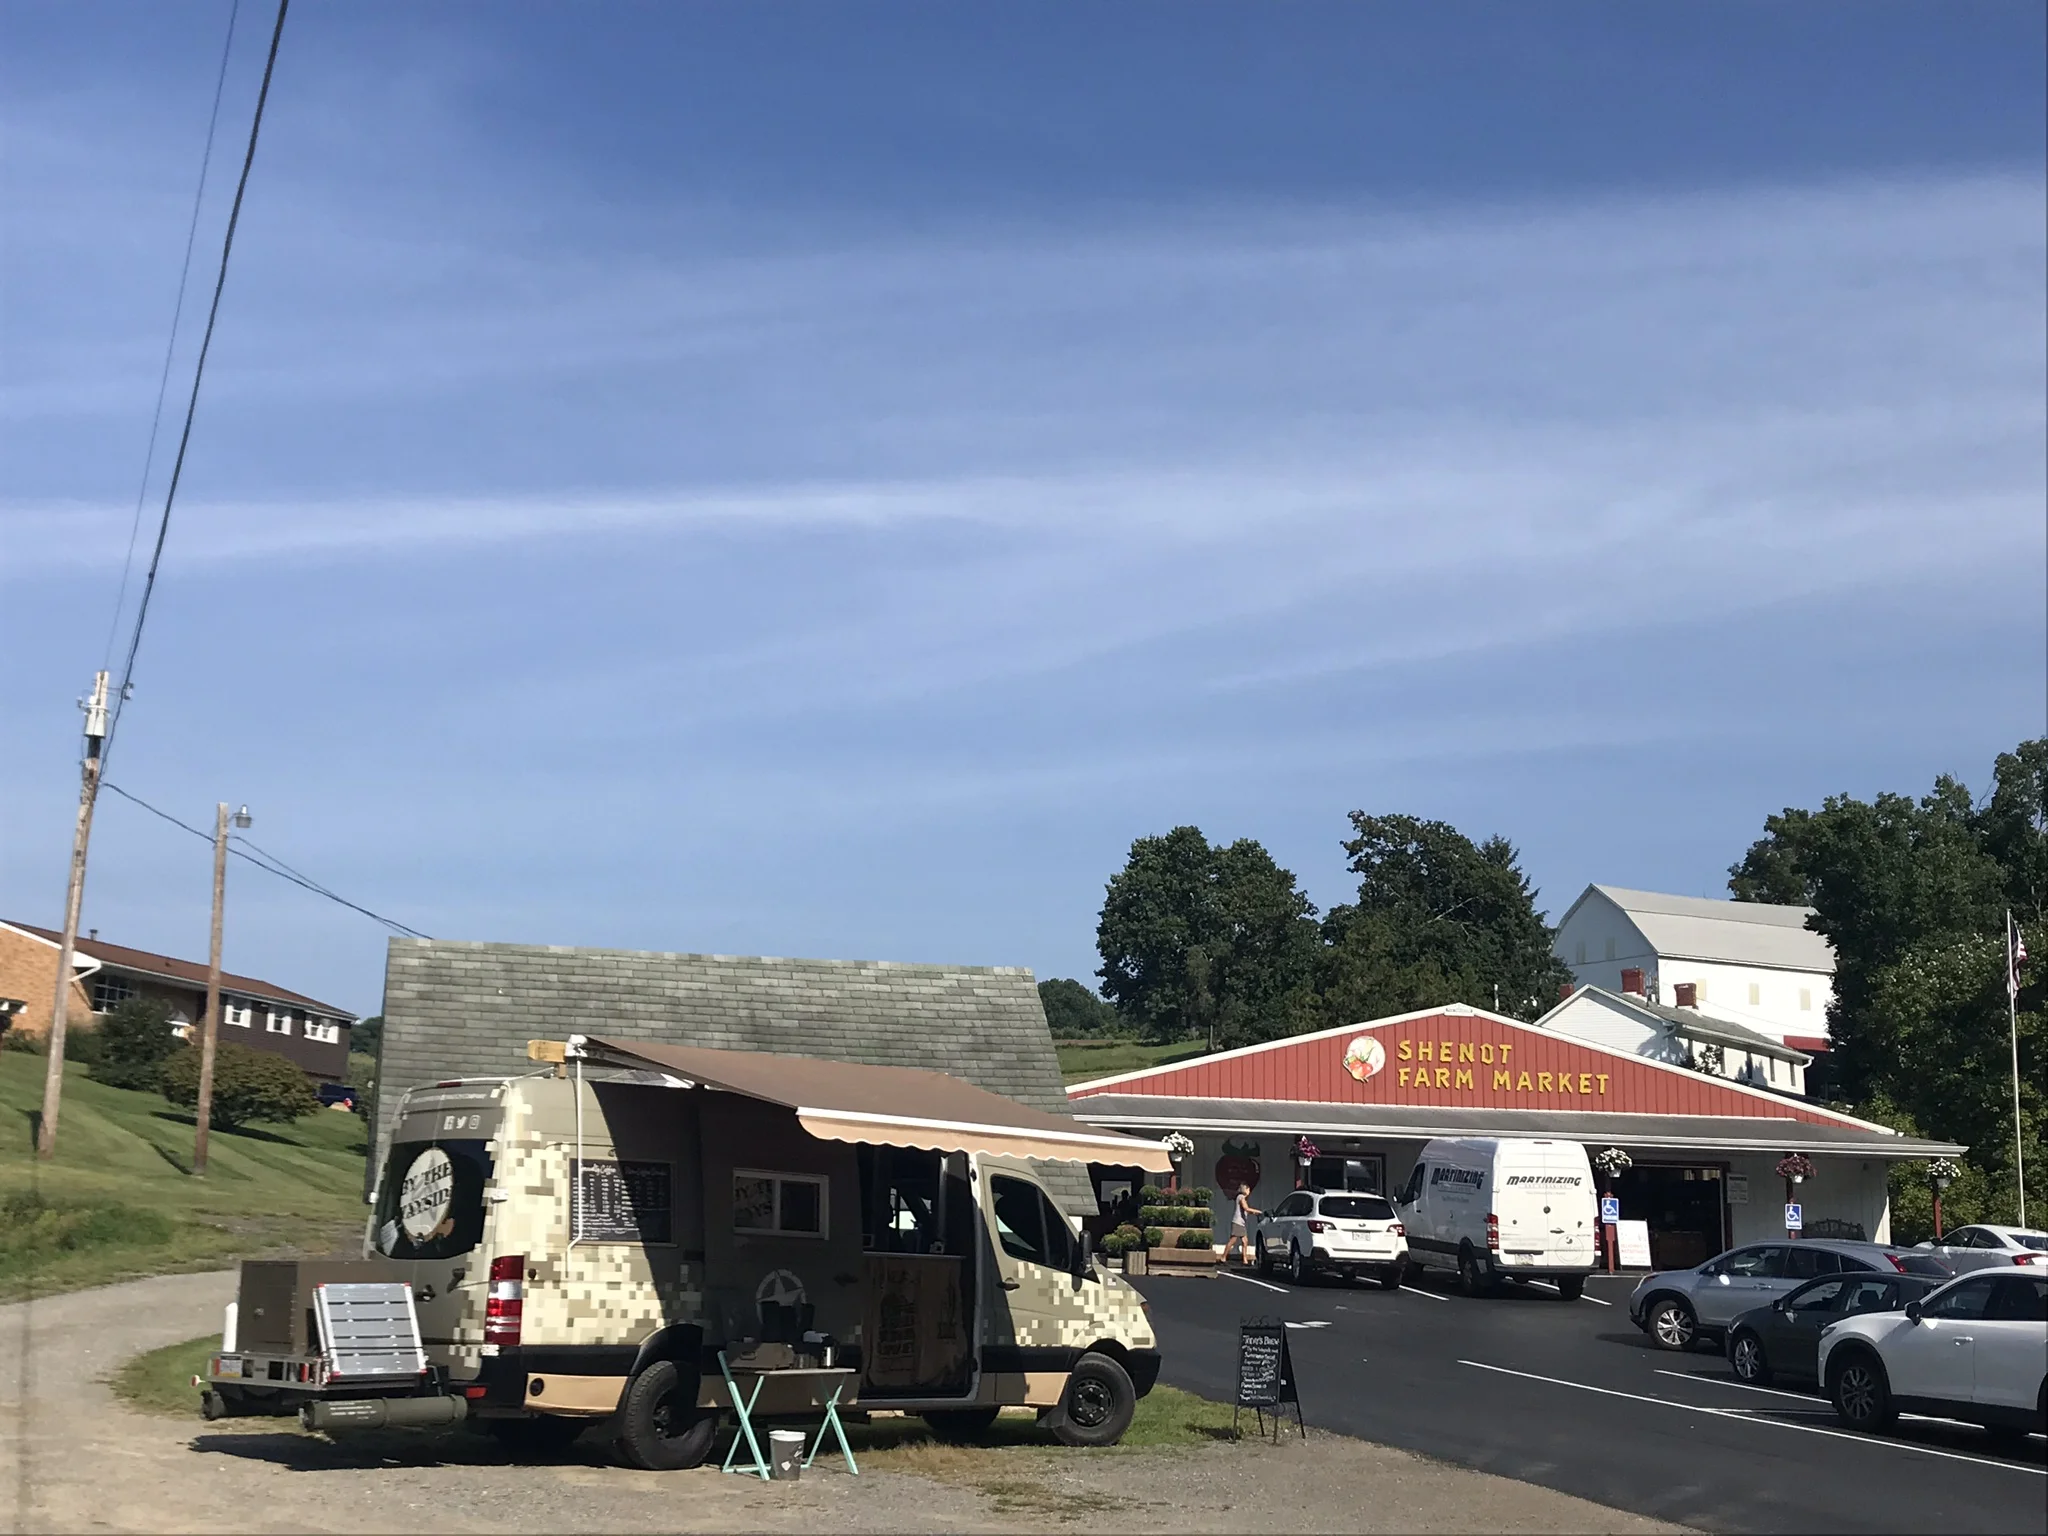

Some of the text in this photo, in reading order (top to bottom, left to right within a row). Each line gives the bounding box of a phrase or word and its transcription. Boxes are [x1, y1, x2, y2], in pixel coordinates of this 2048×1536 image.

[1398, 1039, 1513, 1065] SHENOT
[1398, 1067, 1610, 1095] FARM MARKET
[421, 1161, 453, 1185] THE
[1431, 1167, 1485, 1190] MARTINIZING
[1506, 1175, 1582, 1187] MARTINIZING
